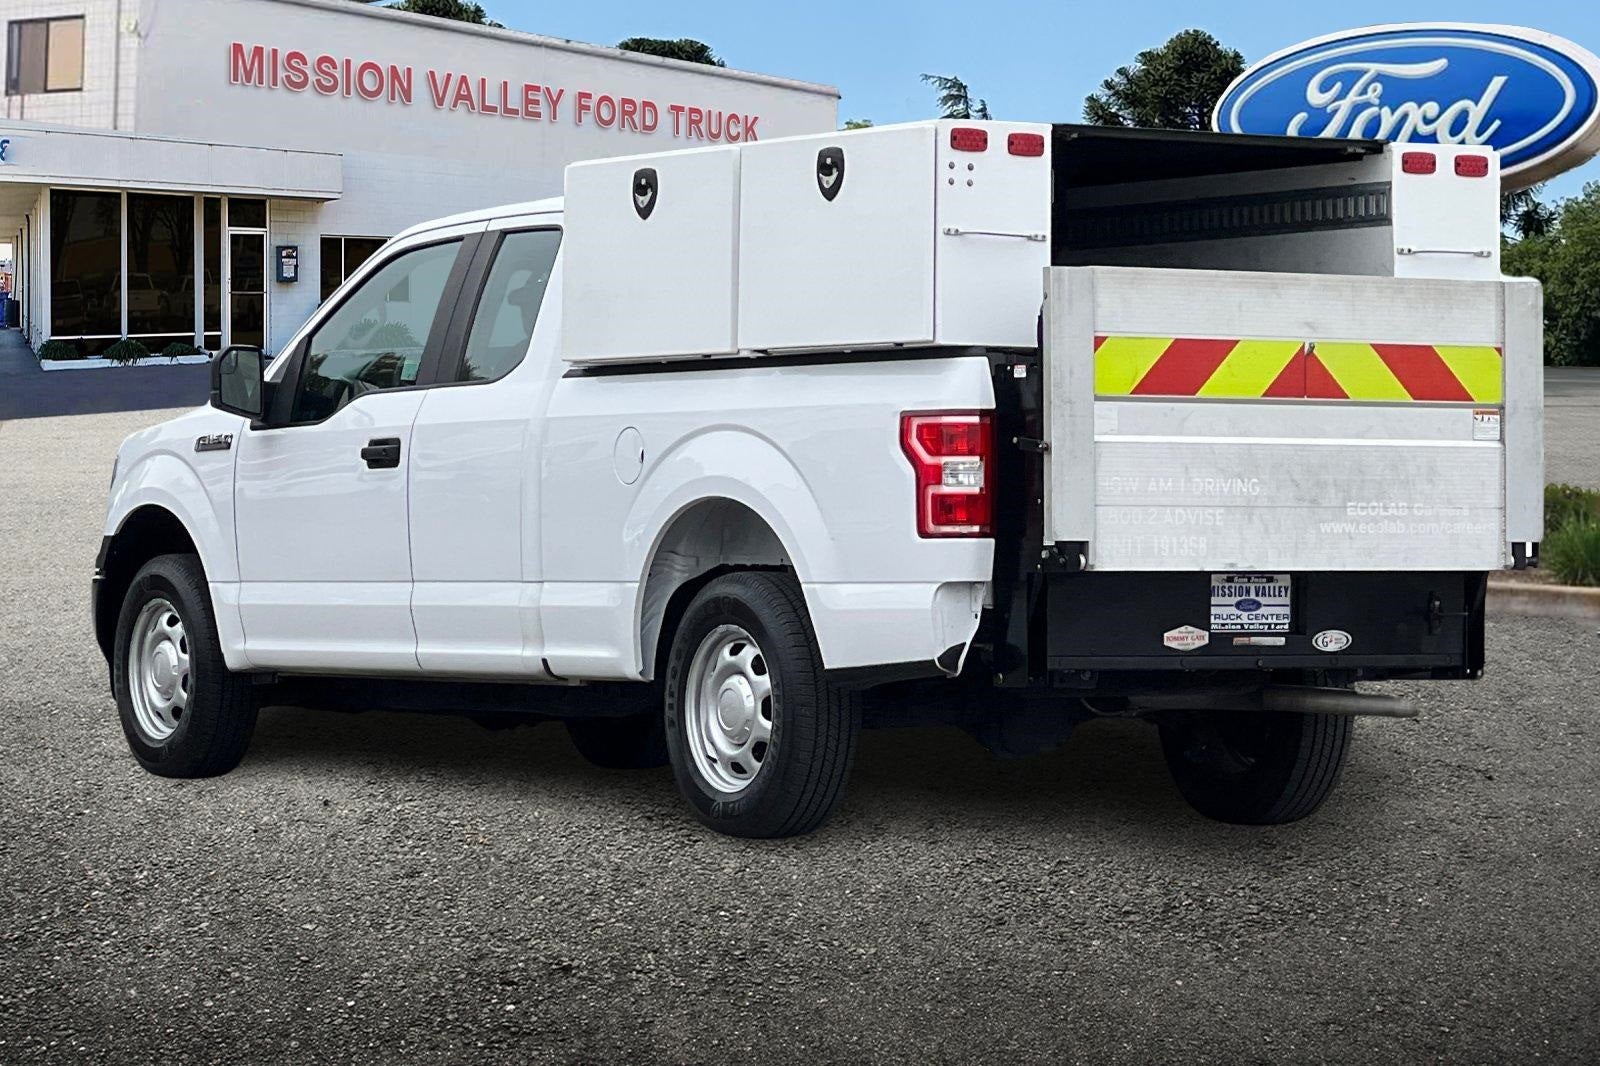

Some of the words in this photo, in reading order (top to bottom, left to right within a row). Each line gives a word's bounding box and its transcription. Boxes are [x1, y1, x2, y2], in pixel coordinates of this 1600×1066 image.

[229, 41, 413, 105] MISSION
[427, 69, 565, 122] VALLEY
[576, 90, 659, 134] FORD
[669, 103, 760, 143] TRUCK
[1286, 57, 1509, 145] Ford
[1148, 477, 1173, 494] AM
[1346, 502, 1409, 516] ECOLAB
[1163, 508, 1225, 526] ADVISE
[1211, 585, 1251, 598] MISSION
[1254, 585, 1290, 598] VALLEY
[1247, 613, 1290, 621] CENTER
[1244, 623, 1269, 631] Valley
